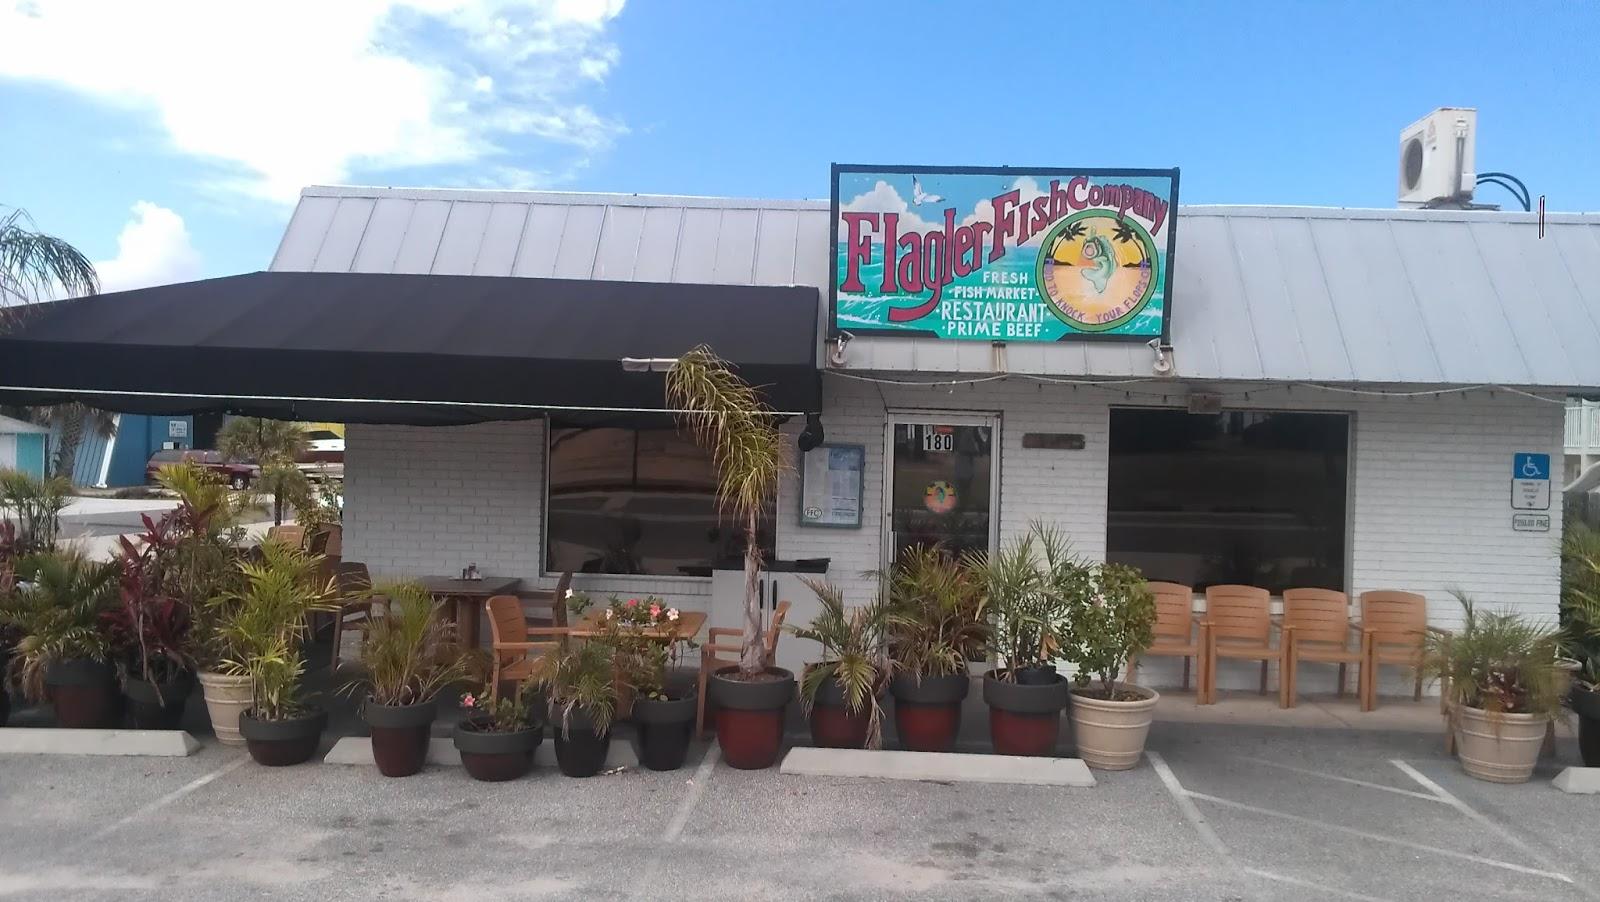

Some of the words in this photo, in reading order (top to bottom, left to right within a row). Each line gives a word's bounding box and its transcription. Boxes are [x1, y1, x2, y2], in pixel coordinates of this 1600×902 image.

[840, 207, 993, 323] Flagler
[1067, 175, 1169, 237] Company
[983, 271, 1028, 285] FRESH
[954, 285, 983, 299] FISH
[985, 287, 1035, 300] MARKET
[1056, 298, 1086, 322] KNOCK
[1096, 307, 1125, 323] YOUR
[1123, 280, 1147, 310] FLOPS
[941, 301, 1048, 323] RESTAURANT
[947, 321, 1001, 337] PRIME
[1006, 323, 1042, 337] BEEF
[925, 434, 952, 450] 180
